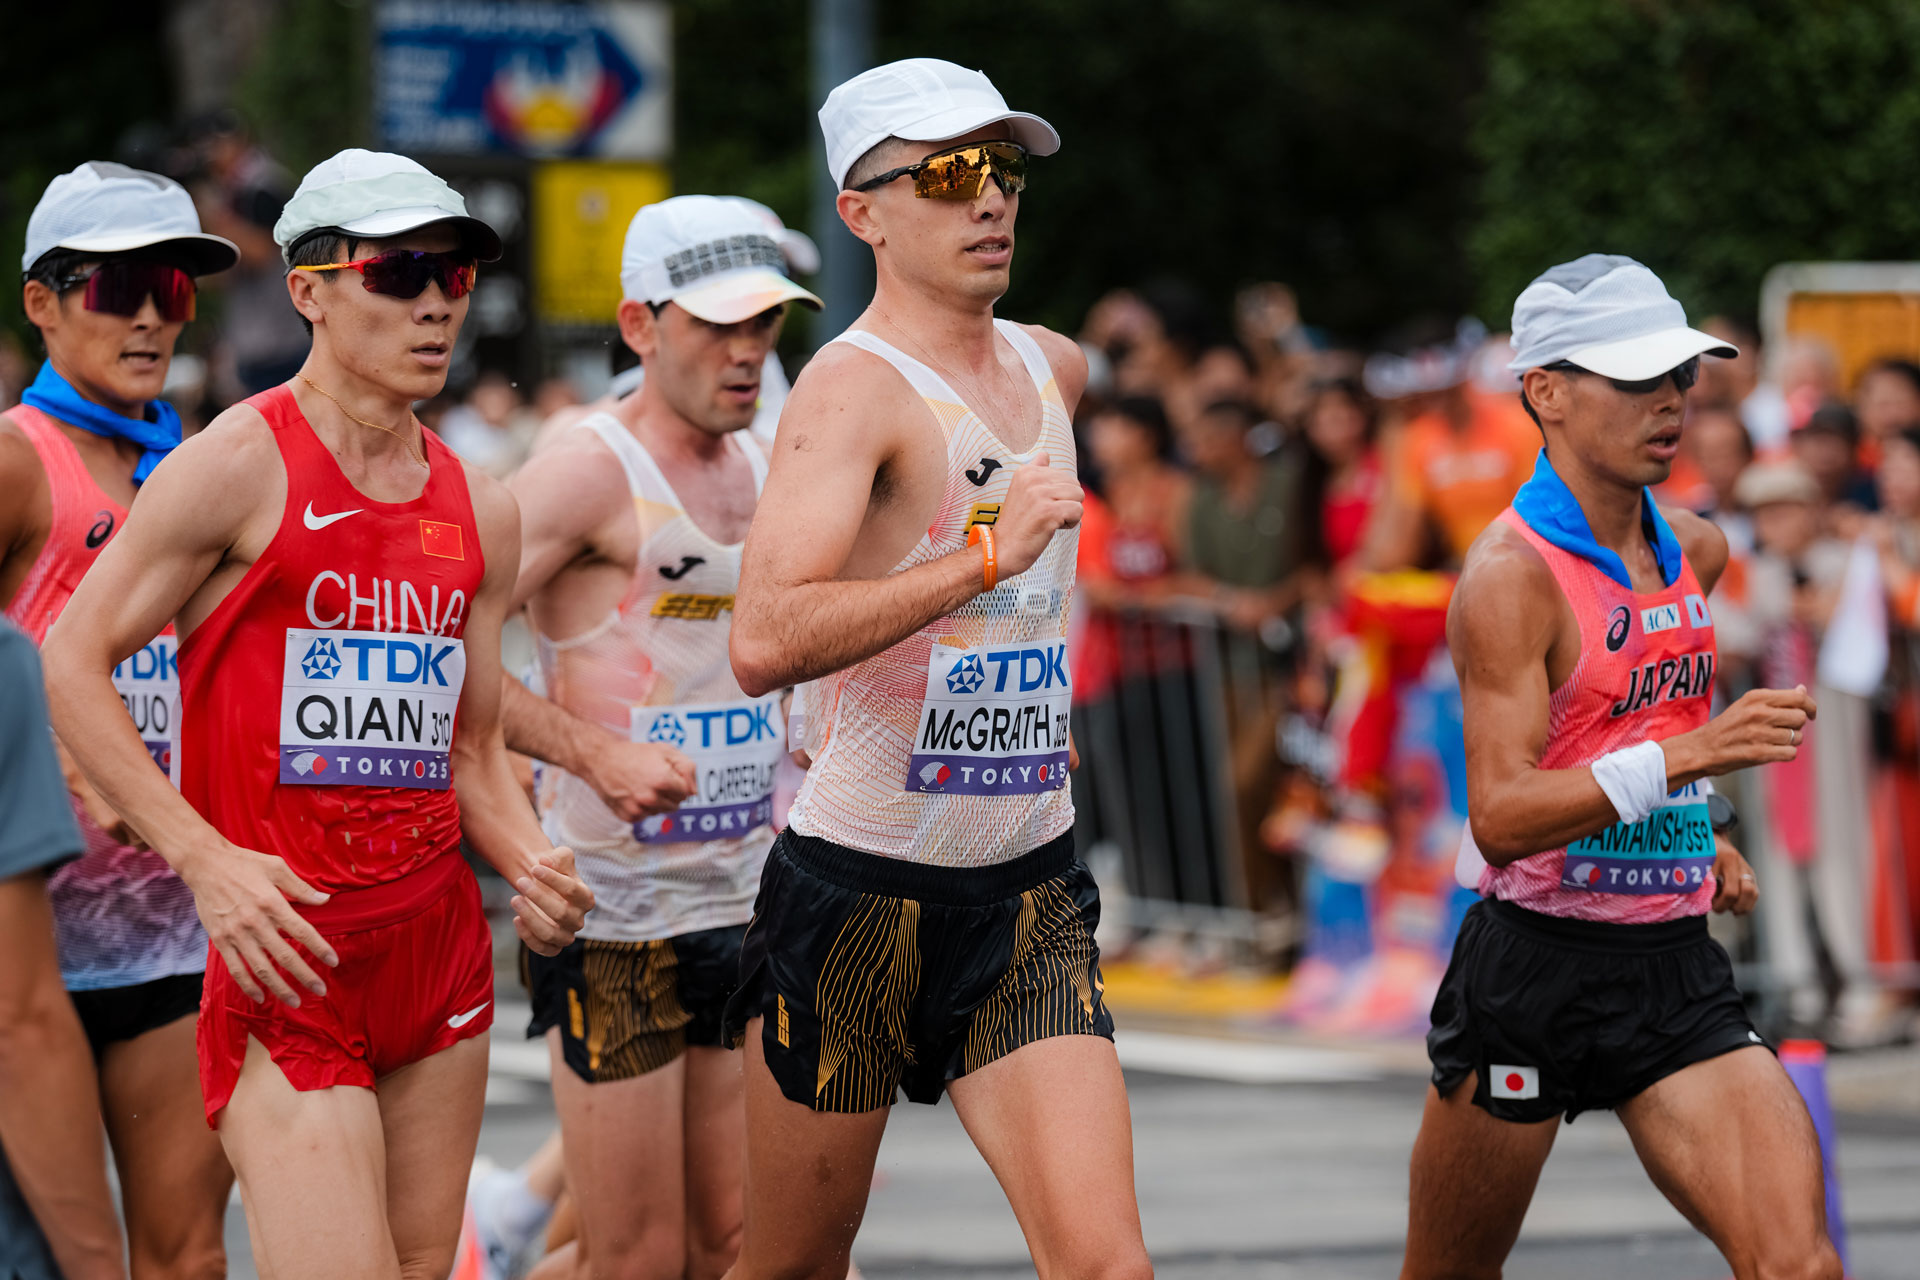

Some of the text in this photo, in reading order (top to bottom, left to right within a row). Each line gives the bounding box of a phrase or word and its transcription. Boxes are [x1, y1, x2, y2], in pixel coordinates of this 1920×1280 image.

[305, 570, 465, 637] CHINA
[1646, 606, 1677, 632] ACN
[342, 638, 456, 687] TDK
[987, 644, 1068, 693] TDK
[1611, 652, 1713, 717] JAPAN
[296, 695, 450, 746] QIAN 310
[686, 702, 776, 748] TDK
[921, 704, 1050, 752] McGRATH
[336, 756, 448, 780] TOKYO25
[960, 761, 1067, 786] TOKYO25
[1686, 820, 1711, 852] 359
[778, 993, 791, 1049] ESP
